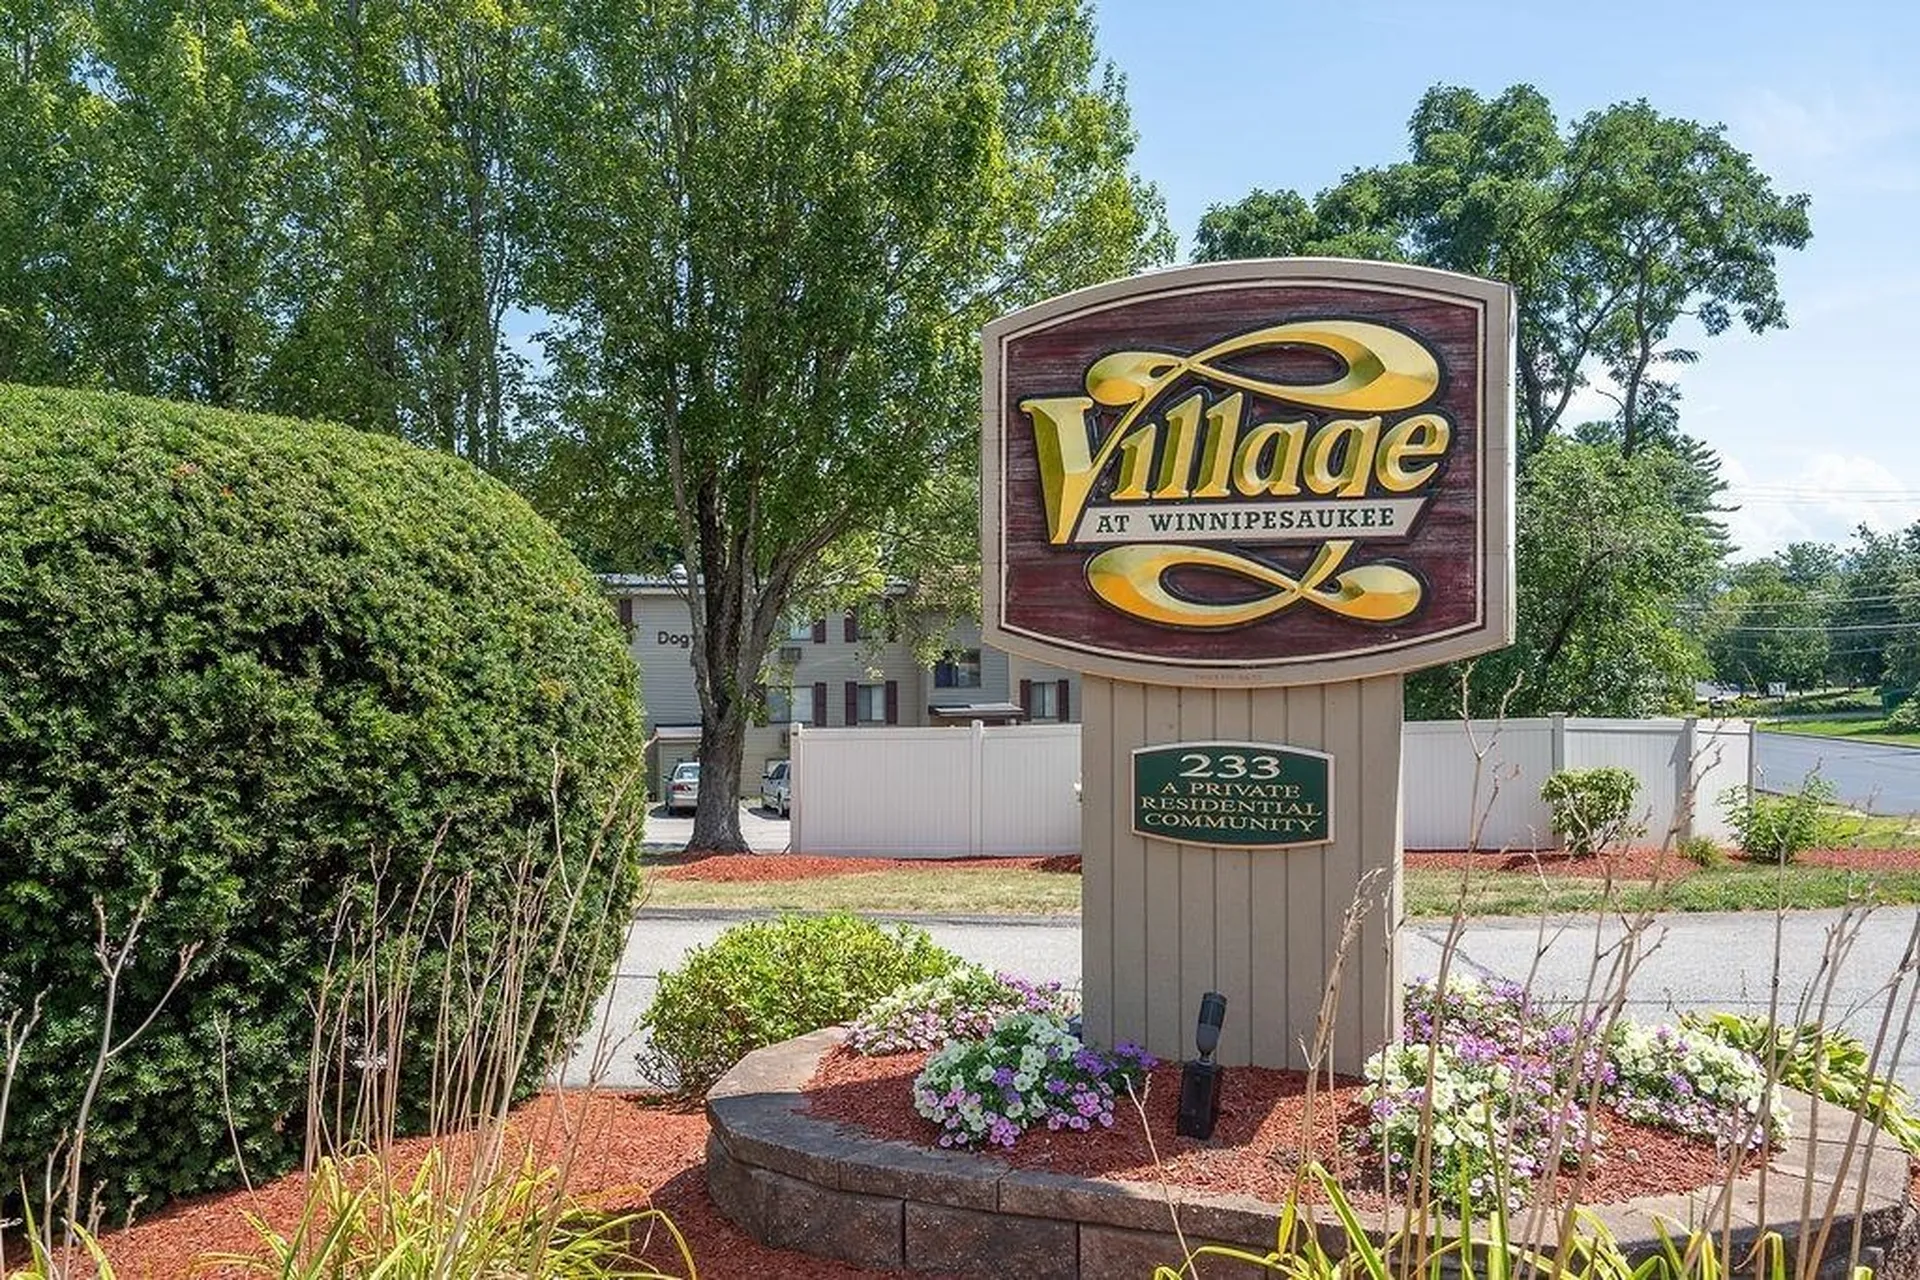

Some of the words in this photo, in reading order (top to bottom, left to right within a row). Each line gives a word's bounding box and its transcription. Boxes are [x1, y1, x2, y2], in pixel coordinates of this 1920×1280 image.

[1019, 320, 1451, 544] Village
[1095, 515, 1130, 534] AT
[1149, 507, 1395, 533] WINNIPESAUKEE
[657, 630, 696, 649] Dog
[1178, 753, 1281, 779] 233
[1161, 782, 1179, 794] A
[1190, 782, 1301, 799] PRIVATE
[1140, 796, 1323, 816] RESIDENTIAL
[1144, 813, 1318, 833] COMMUNITY
